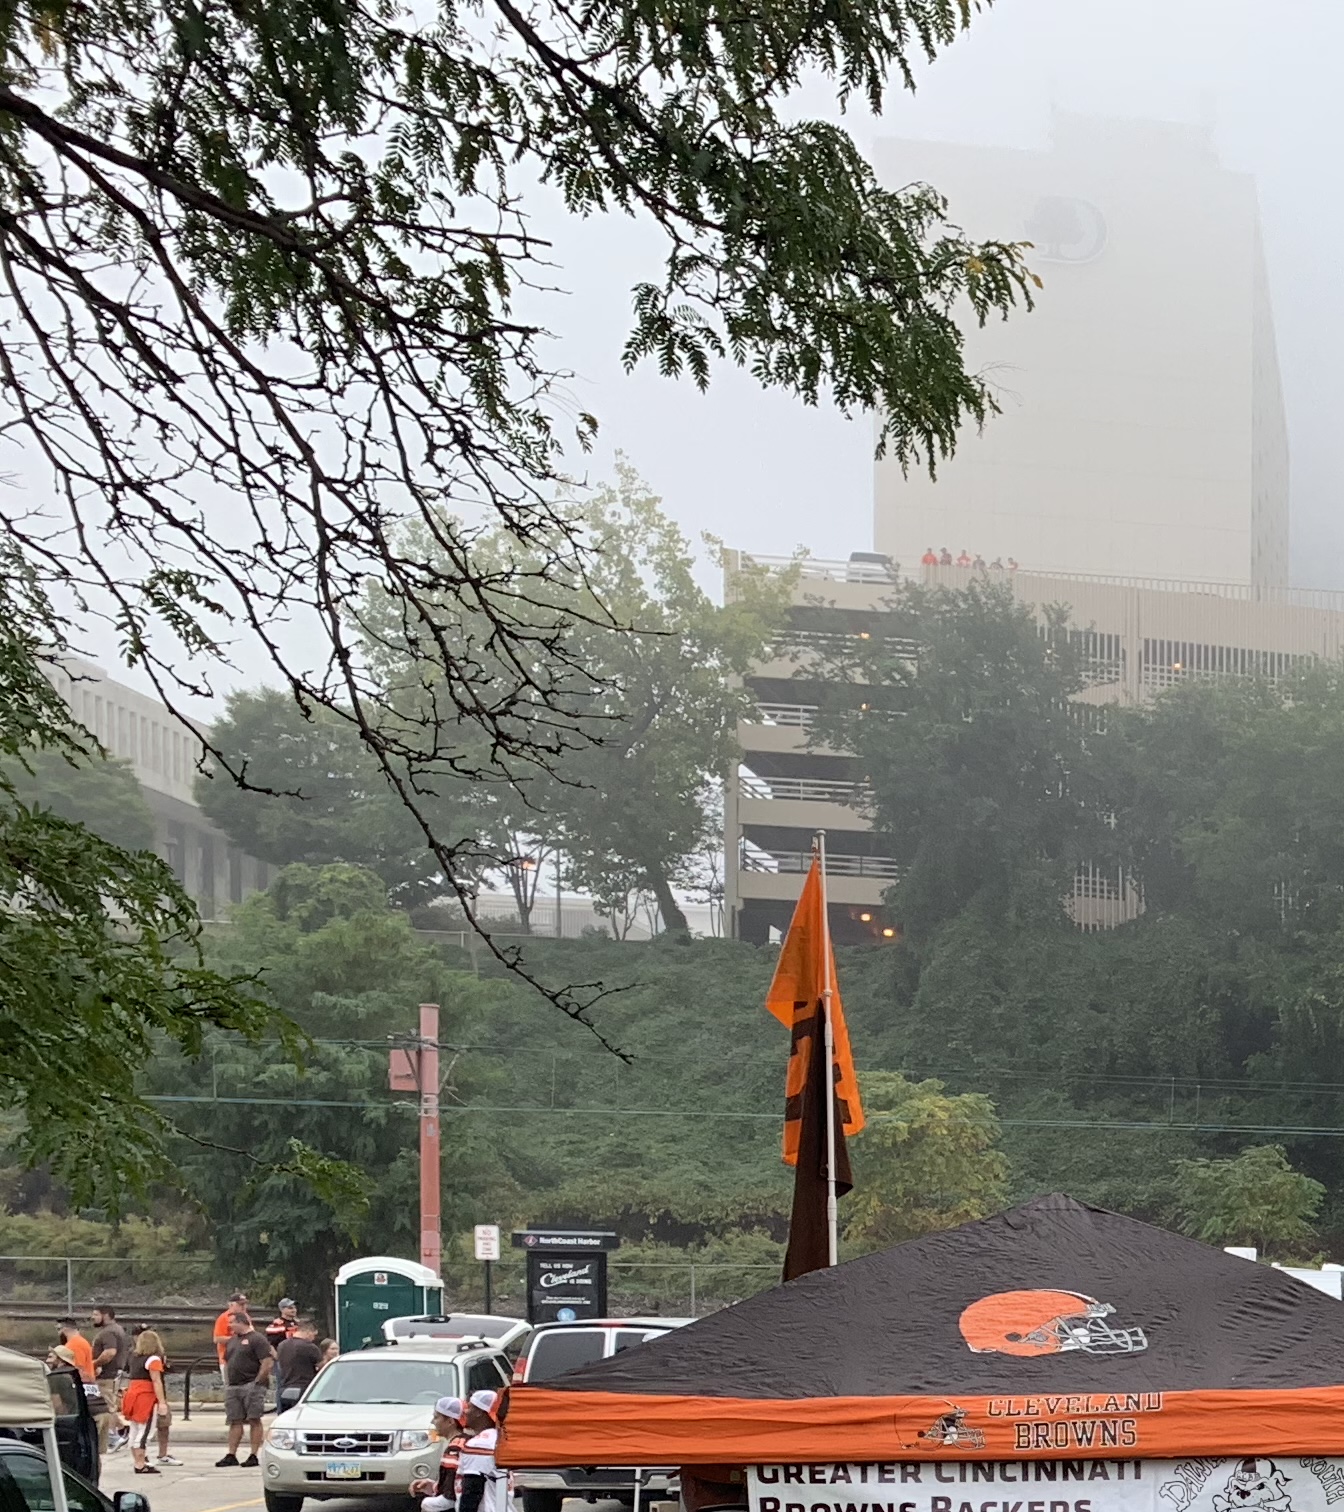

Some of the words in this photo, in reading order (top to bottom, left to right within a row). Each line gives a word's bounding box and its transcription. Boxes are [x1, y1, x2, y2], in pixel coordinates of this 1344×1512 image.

[539, 1237, 577, 1245] NorthCoast
[577, 1238, 601, 1246] Harbor
[539, 1264, 592, 1288] Cleveland
[987, 1391, 1163, 1417] CLEVELAND
[1014, 1419, 1137, 1451] BROWNS
[756, 1460, 921, 1484] GREATER
[934, 1459, 1142, 1483] CINCINNATI
